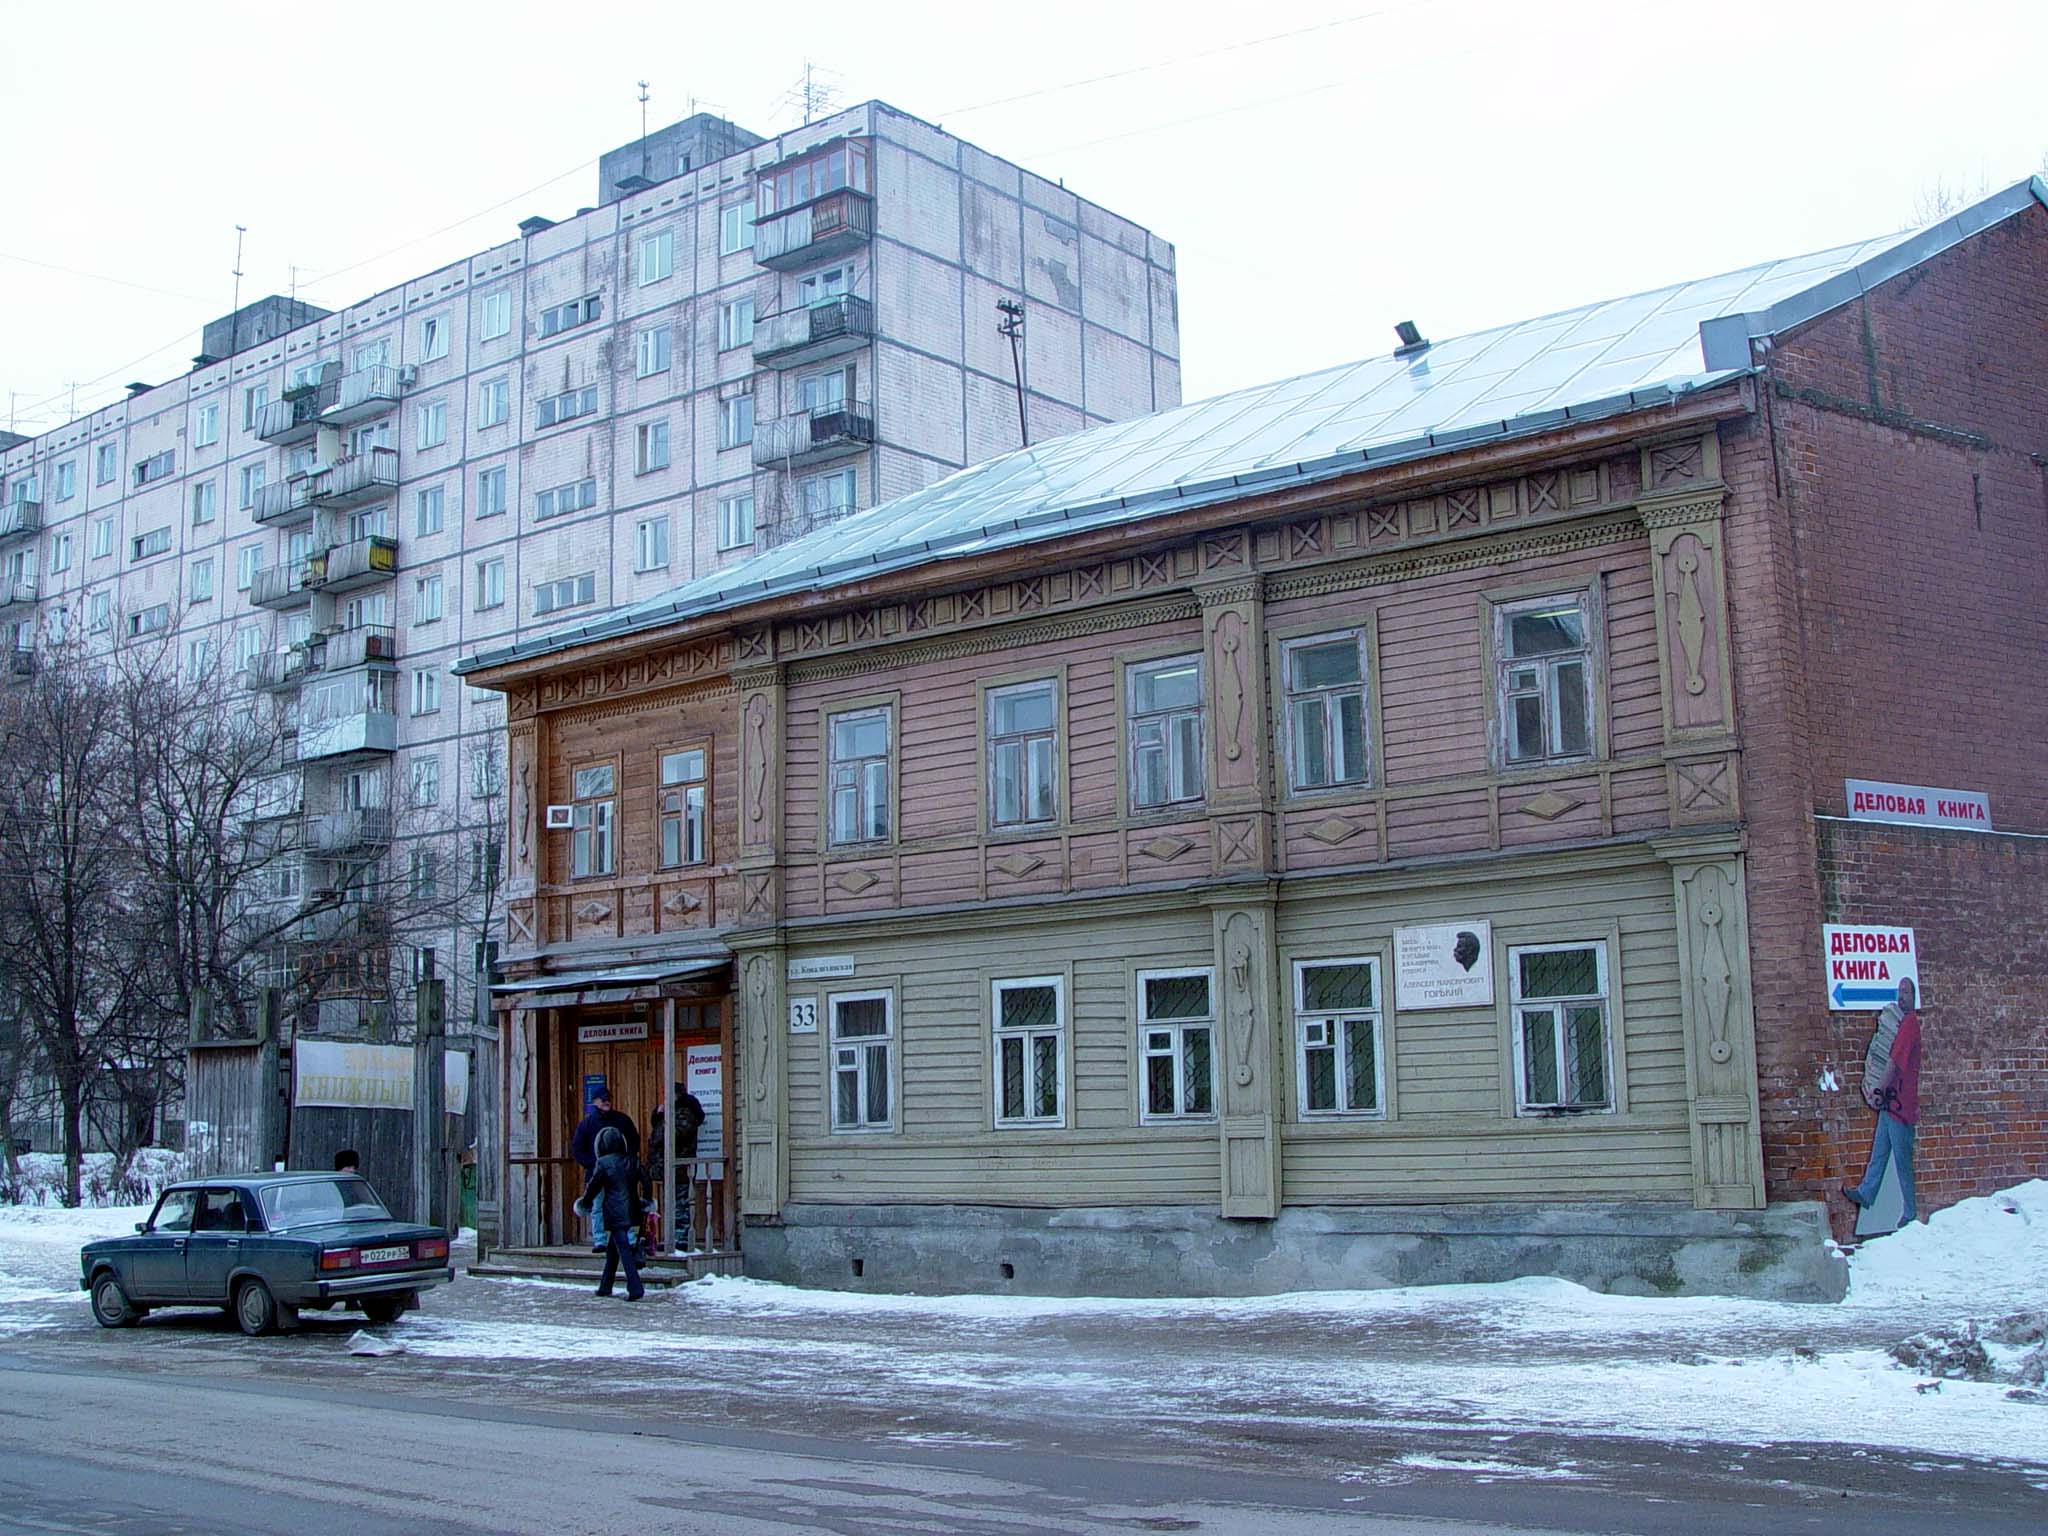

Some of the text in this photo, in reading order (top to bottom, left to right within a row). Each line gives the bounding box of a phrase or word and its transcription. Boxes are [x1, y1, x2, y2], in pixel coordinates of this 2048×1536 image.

[1853, 791, 1986, 821] ДЕЛОВАЯ КНИГА
[1831, 932, 1910, 956] ДЕЛОВАЯ
[1832, 960, 1890, 980] КНИГА
[1424, 987, 1463, 999] ГОРЬКИЙ
[792, 1004, 815, 1028] 33
[583, 1025, 643, 1040] ДЕЛОВАЯ КНИГА
[688, 1055, 722, 1065] Деловая
[300, 1074, 411, 1104] КНИЖНЫЙ
